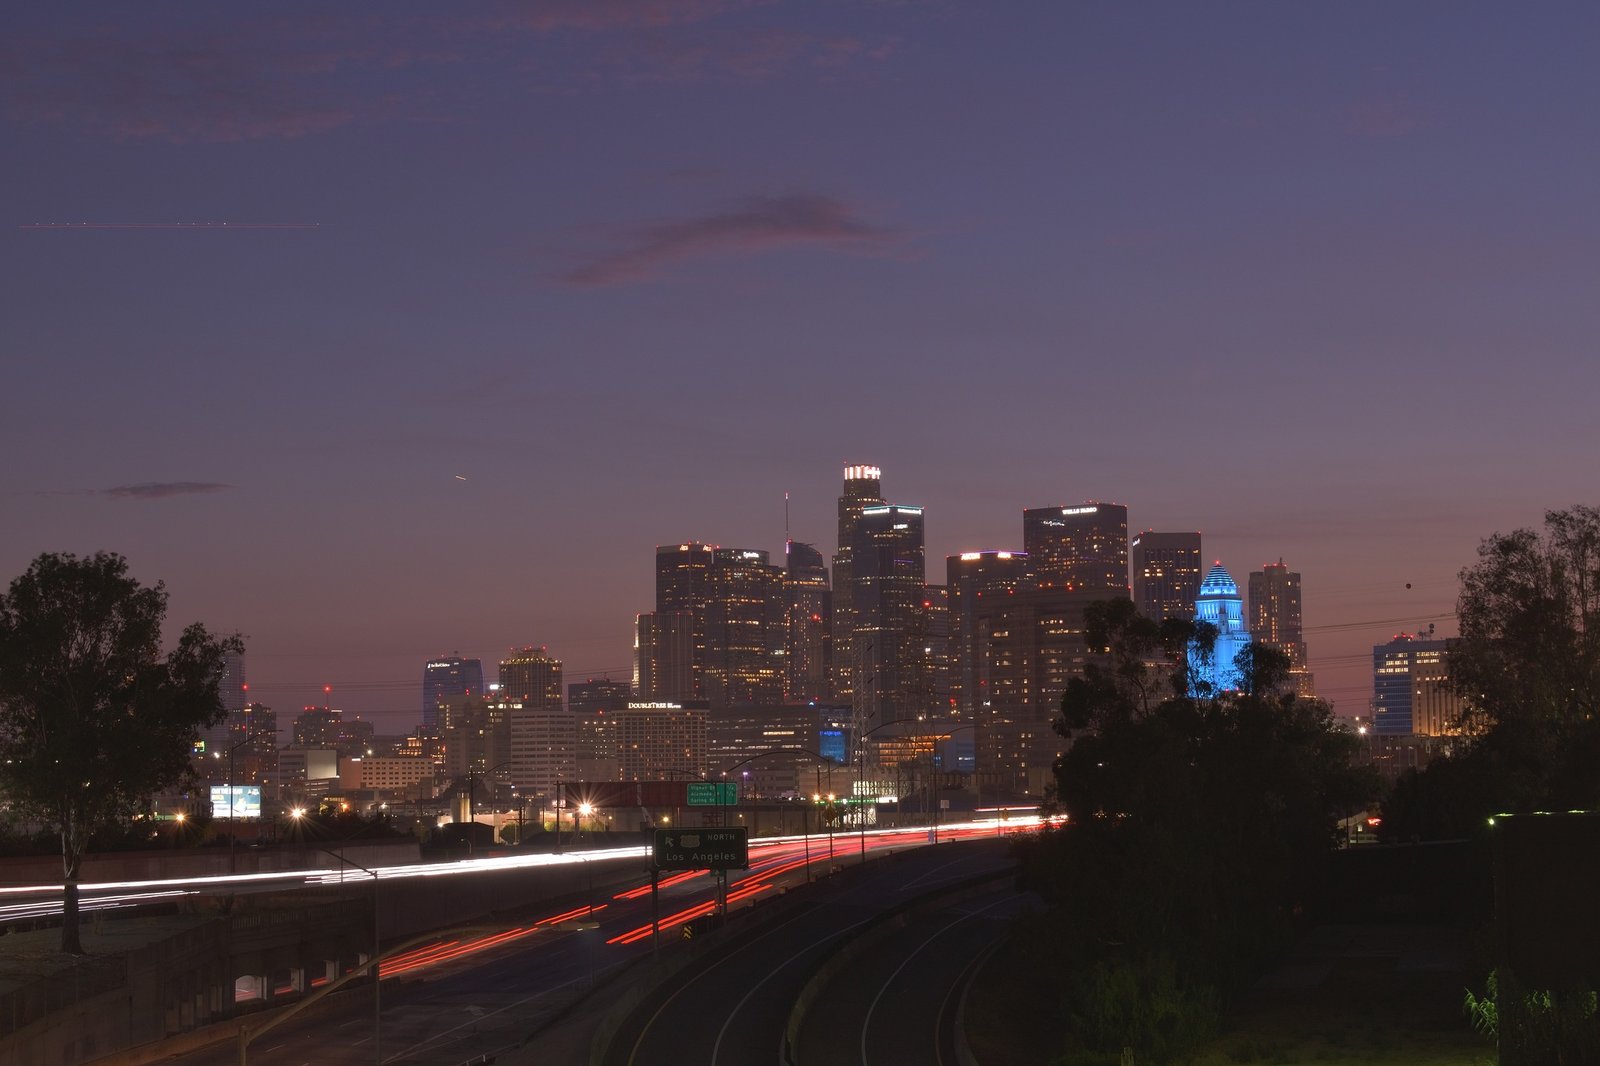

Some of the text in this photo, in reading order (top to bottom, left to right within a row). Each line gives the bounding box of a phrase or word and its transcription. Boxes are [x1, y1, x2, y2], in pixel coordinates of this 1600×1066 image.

[707, 833, 735, 841] NORTH
[666, 852, 736, 863] Los Angeles
